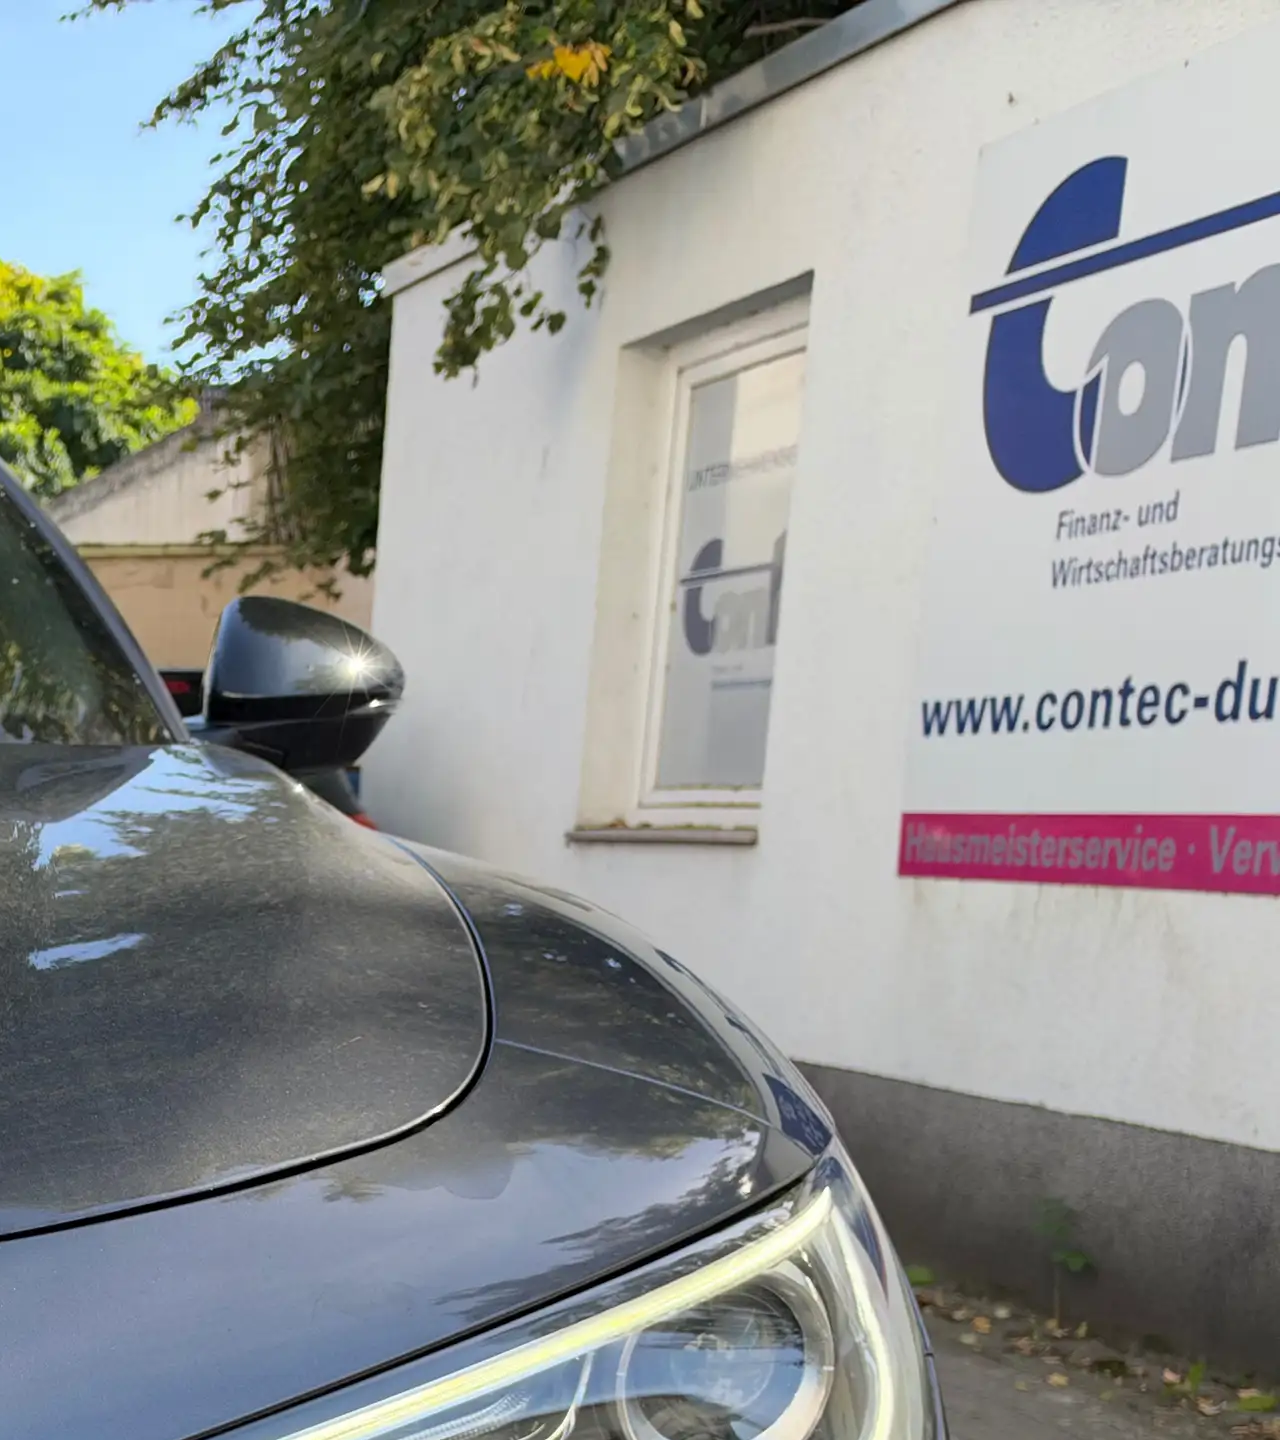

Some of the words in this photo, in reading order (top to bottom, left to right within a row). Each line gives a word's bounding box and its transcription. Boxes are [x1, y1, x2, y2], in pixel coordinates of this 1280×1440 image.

[1055, 508, 1130, 541] Finanz-
[1137, 489, 1181, 528] und
[920, 658, 1280, 738] www.contec-du
